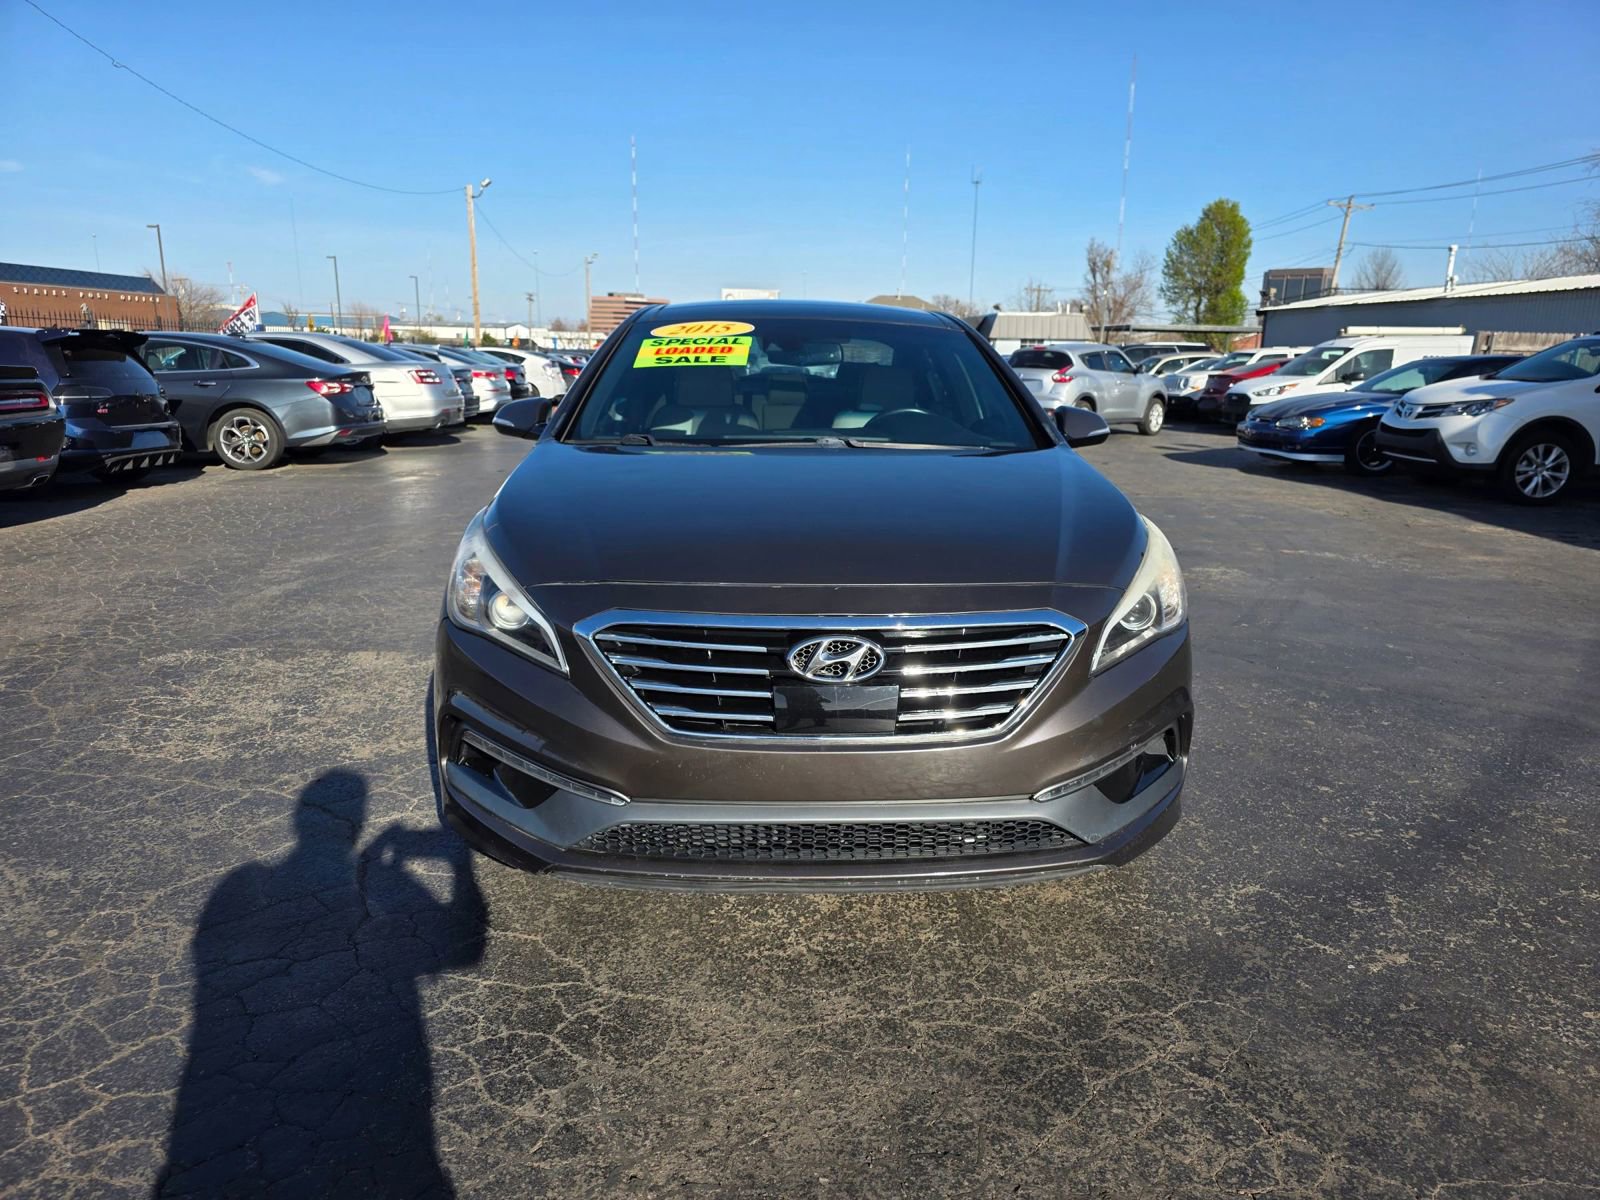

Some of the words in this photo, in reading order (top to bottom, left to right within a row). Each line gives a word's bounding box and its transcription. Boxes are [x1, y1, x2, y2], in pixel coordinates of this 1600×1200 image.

[79, 291, 109, 300] POST
[668, 324, 736, 335] 2015
[650, 338, 744, 346] SPECIAL
[654, 346, 733, 355] LOADED
[655, 356, 727, 364] SALE
